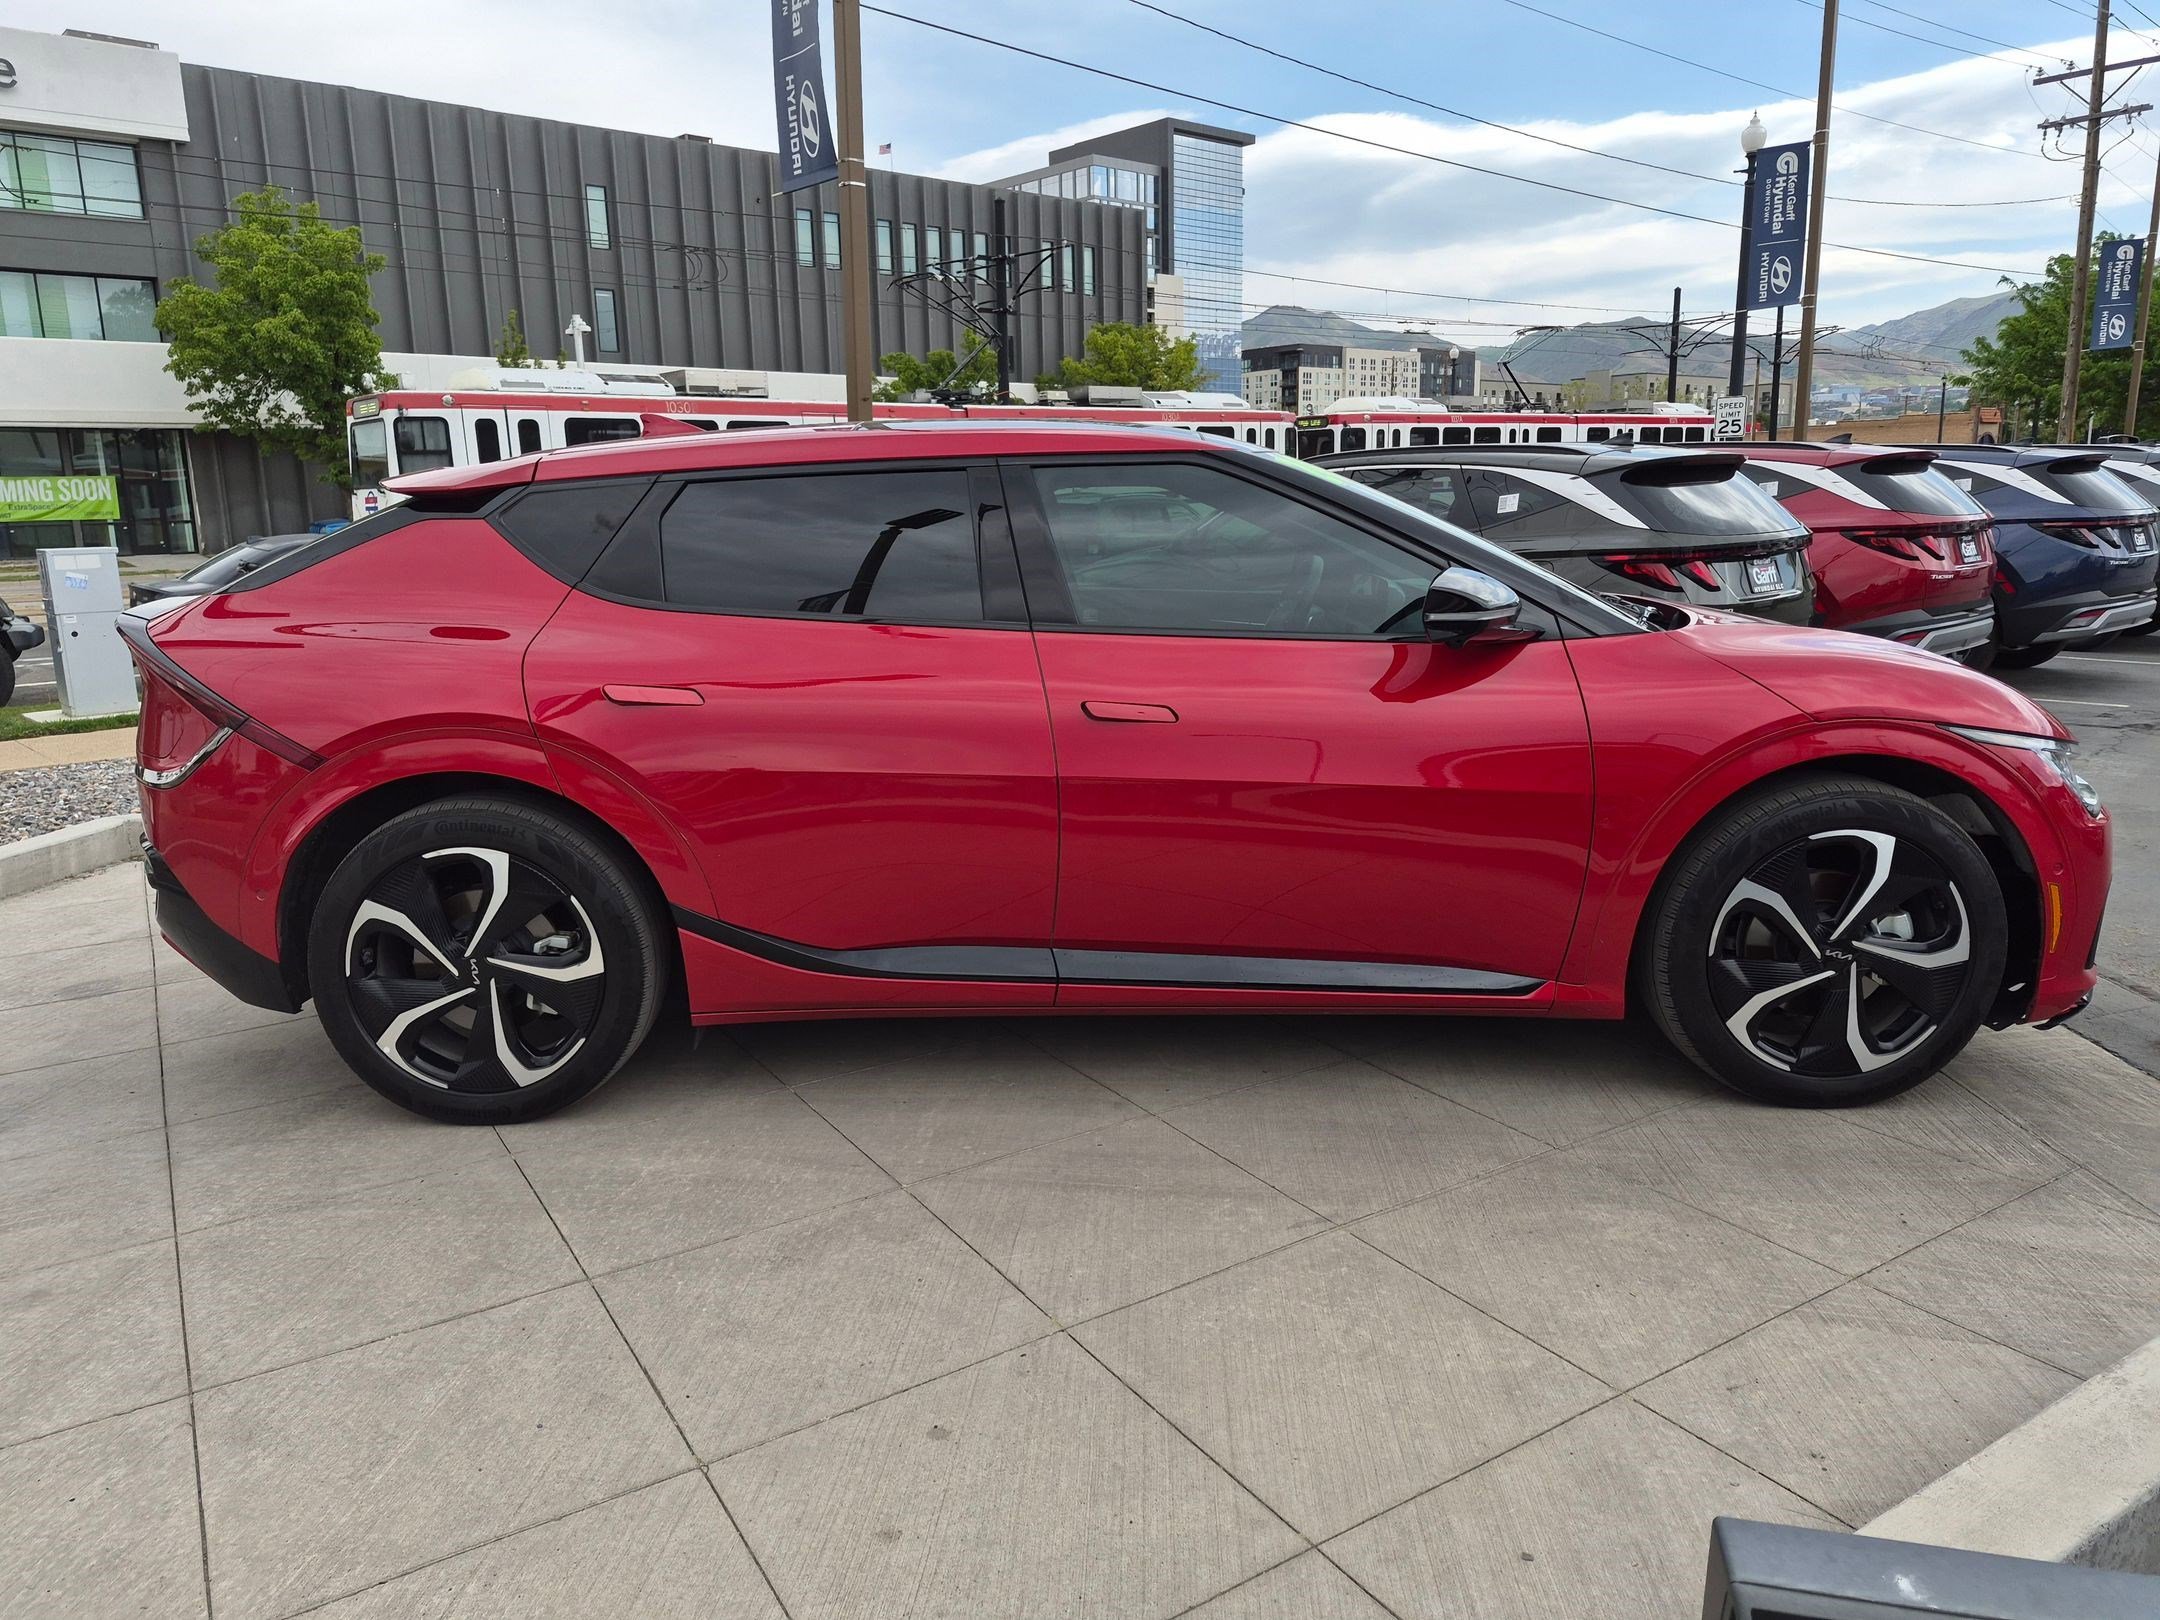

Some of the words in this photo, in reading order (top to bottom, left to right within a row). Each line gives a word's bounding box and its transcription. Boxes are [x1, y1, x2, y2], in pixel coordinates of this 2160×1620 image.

[785, 74, 803, 176] HYUNDAI
[1787, 175, 1797, 193] Ken
[1772, 177, 1787, 235] Hyundai
[1786, 196, 1796, 221] Garff
[1758, 252, 1770, 303] HYUNDAI
[2112, 261, 2124, 300] Hyundai
[2099, 310, 2109, 345] HYUNDAI
[1719, 402, 1745, 410] SPEED
[1717, 419, 1742, 434] 25
[57, 478, 112, 503] SOON
[1753, 566, 1777, 584] Garff
